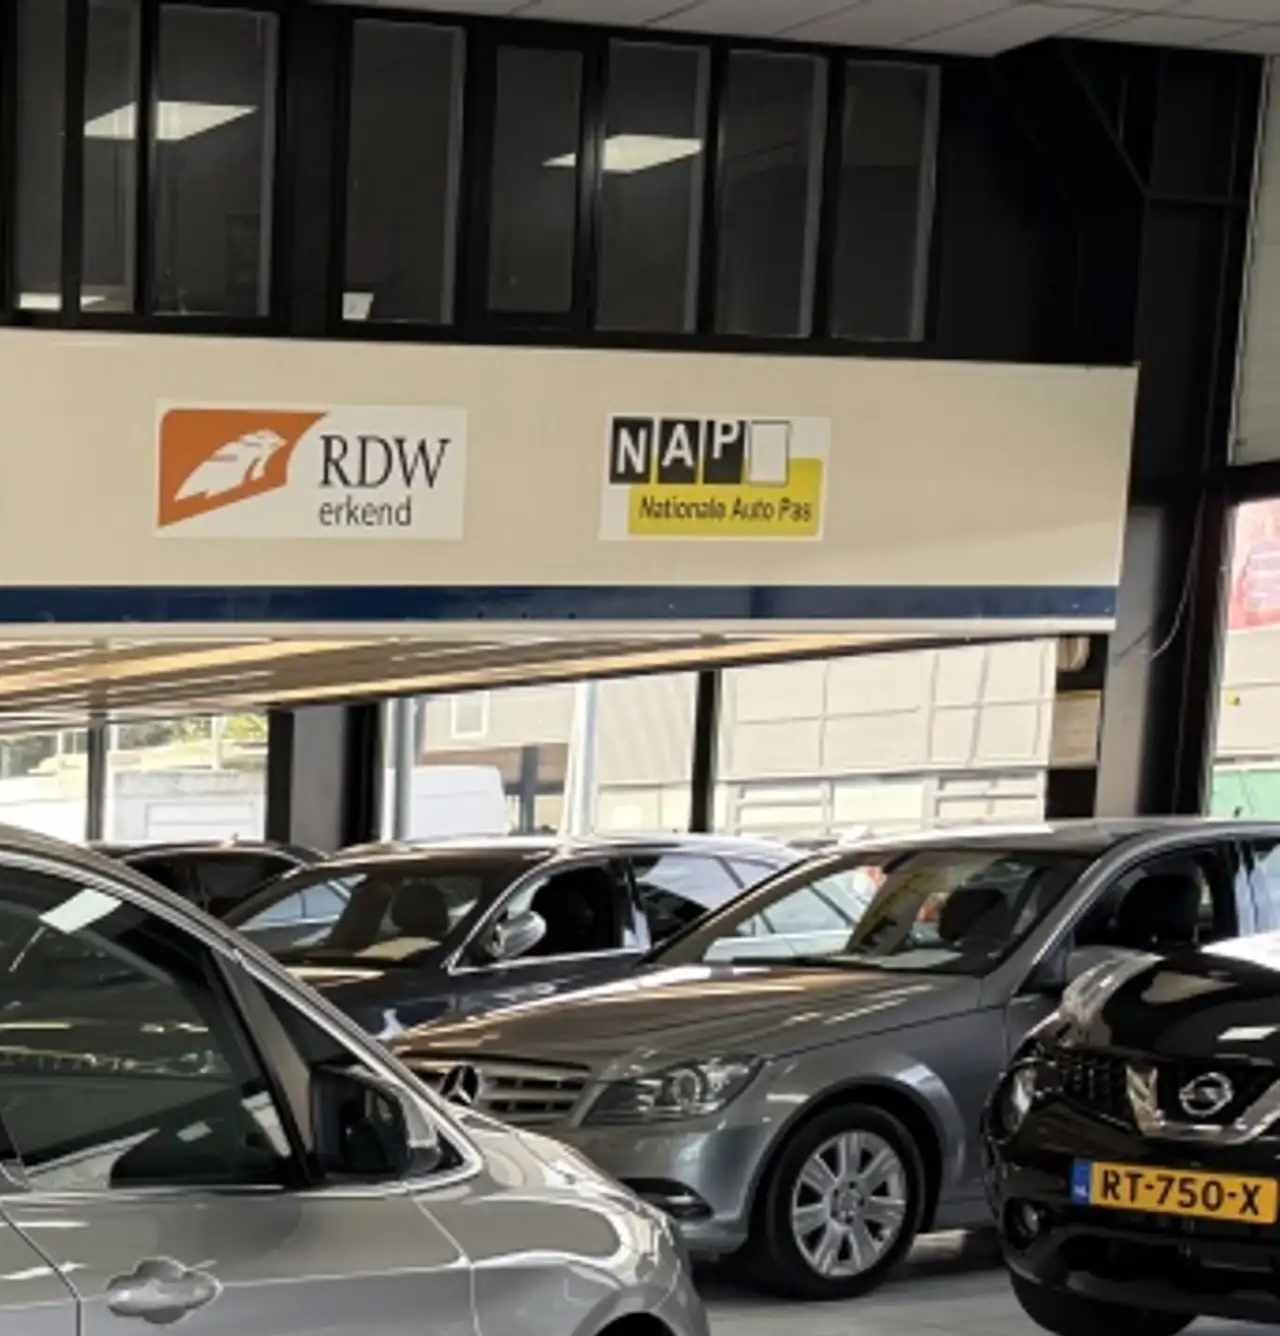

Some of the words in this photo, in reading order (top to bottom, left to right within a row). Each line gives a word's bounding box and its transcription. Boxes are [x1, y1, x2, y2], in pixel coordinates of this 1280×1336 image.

[318, 434, 451, 488] RDW
[616, 419, 741, 474] NAP
[318, 495, 412, 527] erkend
[640, 495, 727, 521] Nationale
[730, 496, 774, 521] Auto
[778, 497, 812, 522] Pas
[1101, 1168, 1262, 1217] RT-750-X
